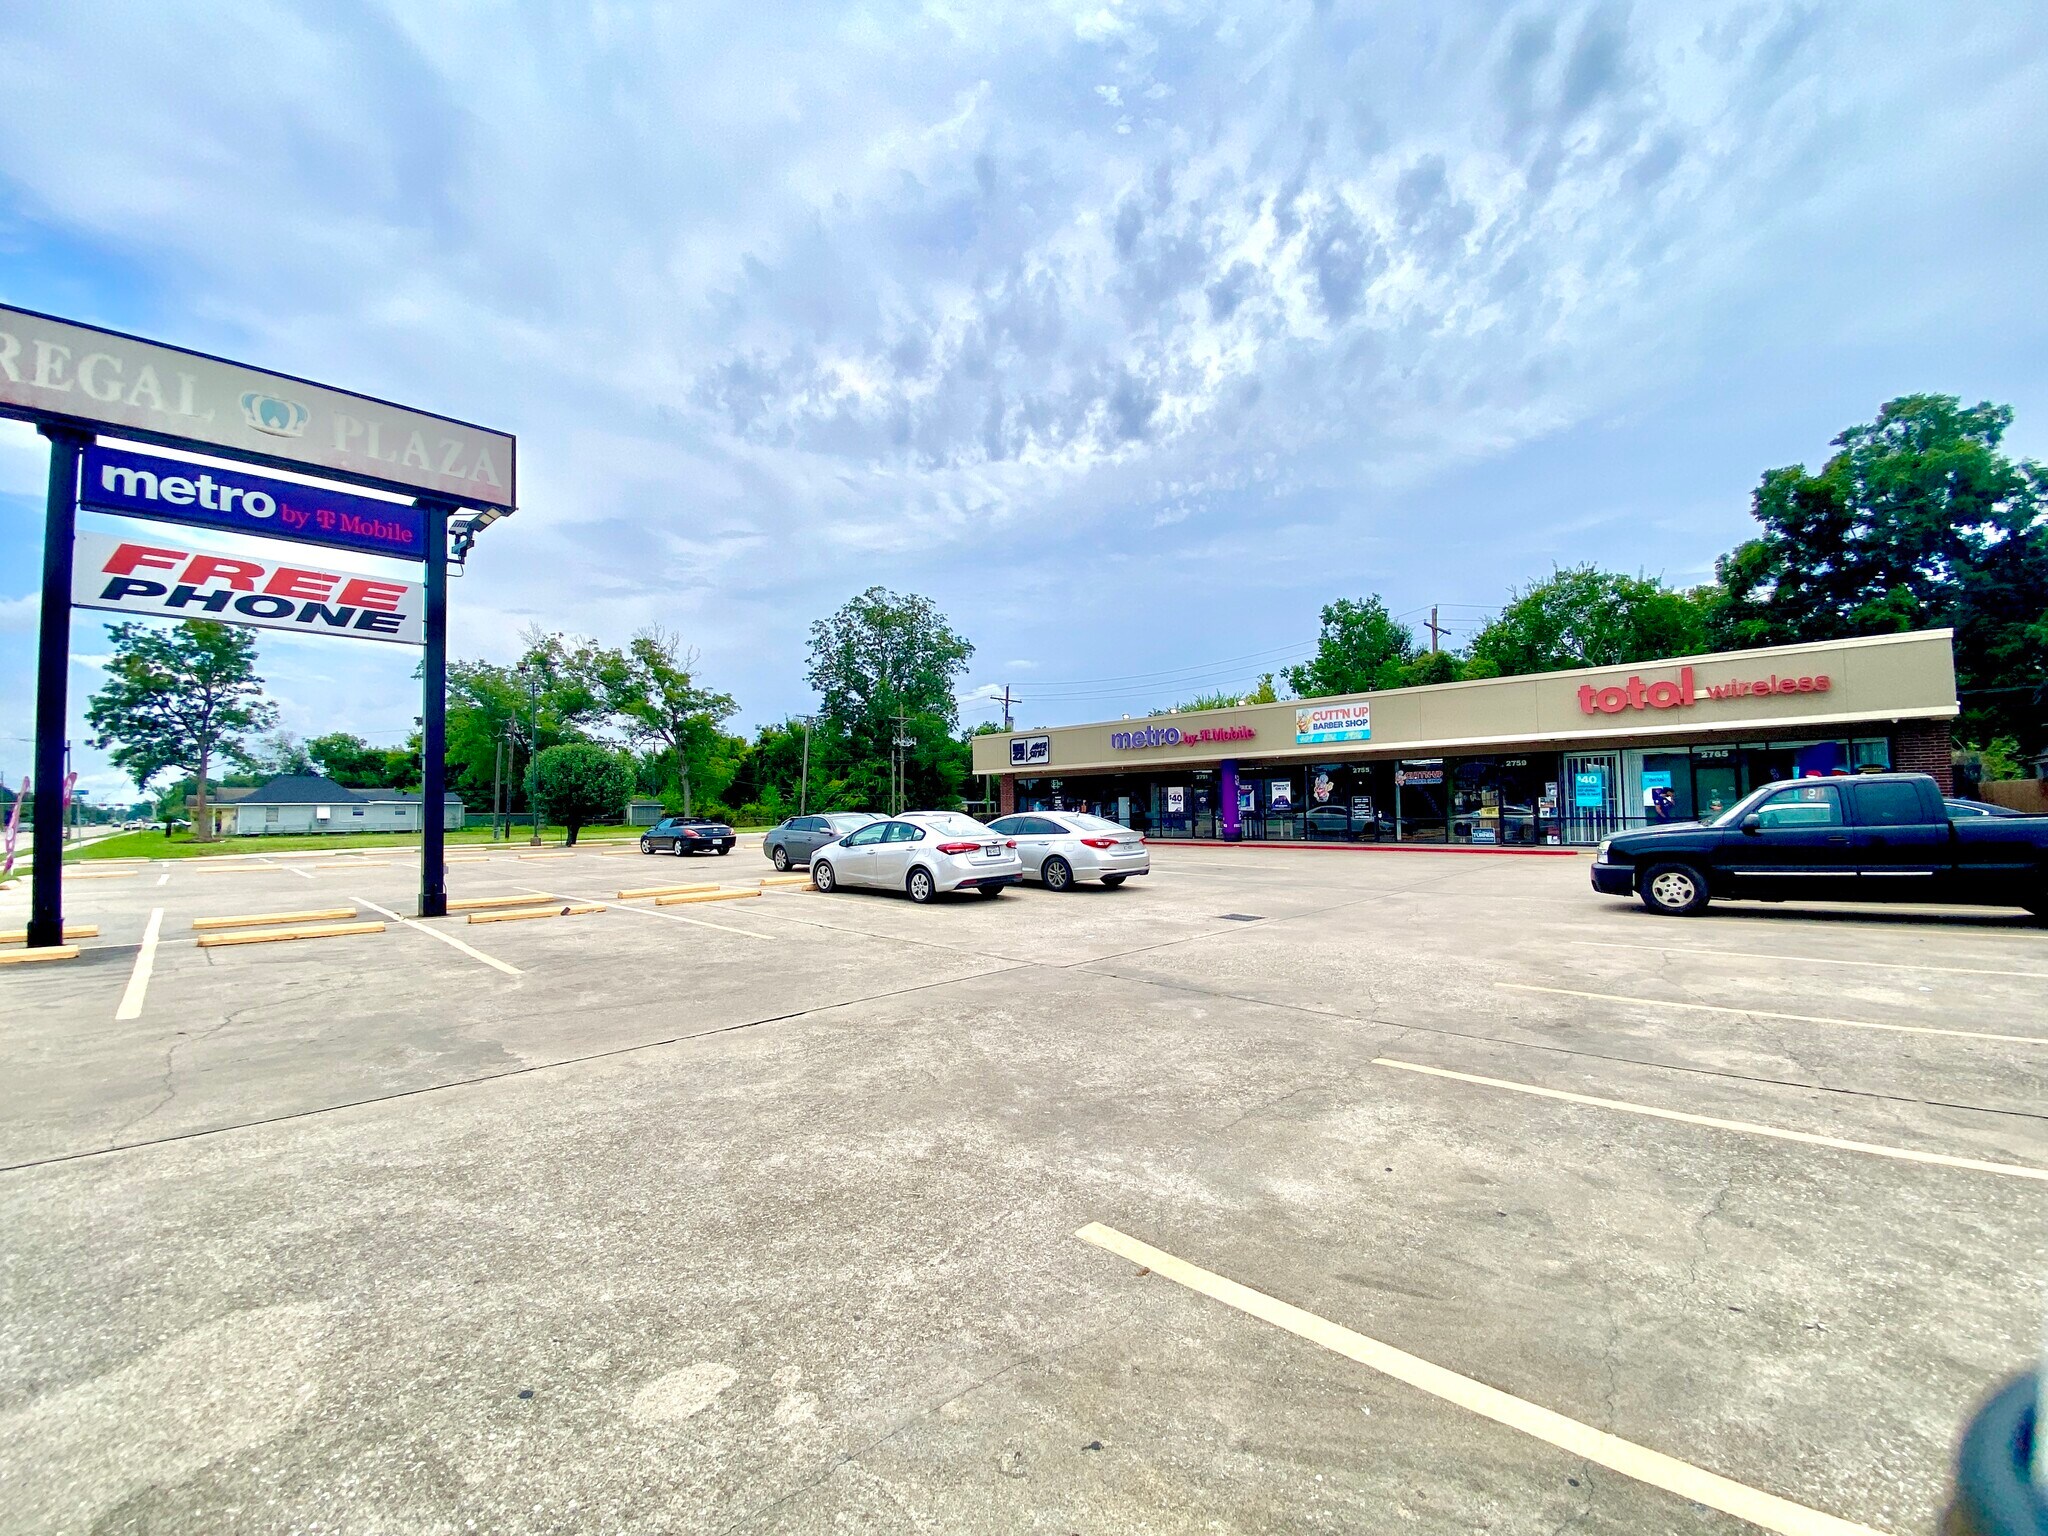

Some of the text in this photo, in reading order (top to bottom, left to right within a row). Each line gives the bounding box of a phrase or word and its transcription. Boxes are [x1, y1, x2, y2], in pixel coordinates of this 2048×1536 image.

[331, 410, 502, 488] PLAZA
[102, 463, 277, 519] metro
[281, 503, 311, 529] by
[339, 512, 413, 543] Mobile
[102, 543, 408, 612] FREE
[99, 576, 407, 634] PHONE
[1578, 666, 1831, 714] total wireless
[1312, 706, 1369, 722] CUTT'N UP
[1312, 718, 1369, 730] BARBER SHOP
[1111, 725, 1181, 749] metro
[1183, 732, 1198, 747] by
[1212, 725, 1256, 742] Mobile
[1505, 759, 1527, 767] 2759
[1701, 750, 1729, 758] 2765
[1577, 775, 1597, 784] $40
[1169, 794, 1182, 802] $40
